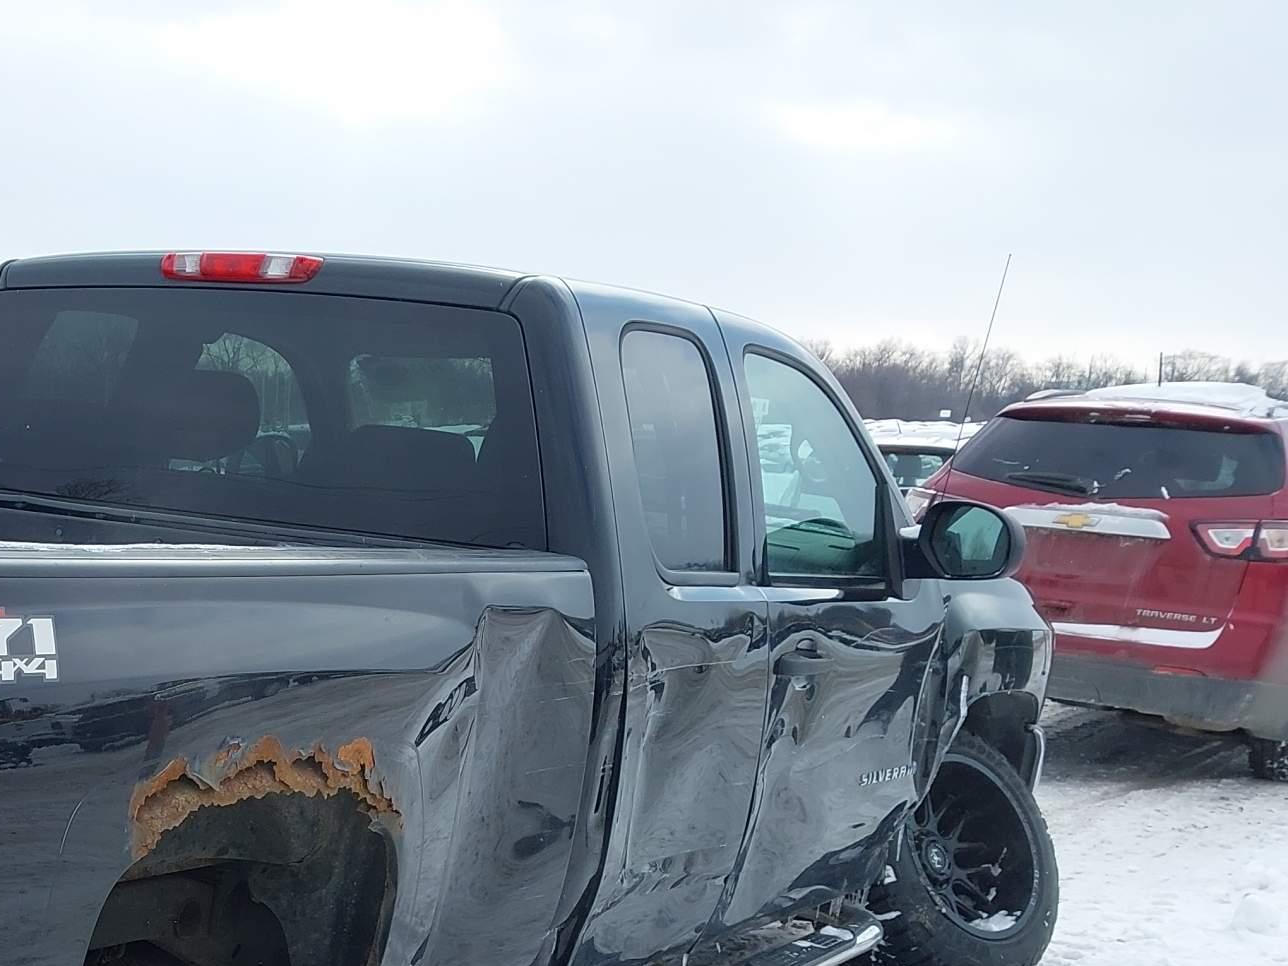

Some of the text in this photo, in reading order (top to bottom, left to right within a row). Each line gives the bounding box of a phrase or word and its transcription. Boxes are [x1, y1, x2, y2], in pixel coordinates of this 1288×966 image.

[1136, 608, 1218, 625] TRAVERSE LT
[859, 761, 918, 787] SILVERA
